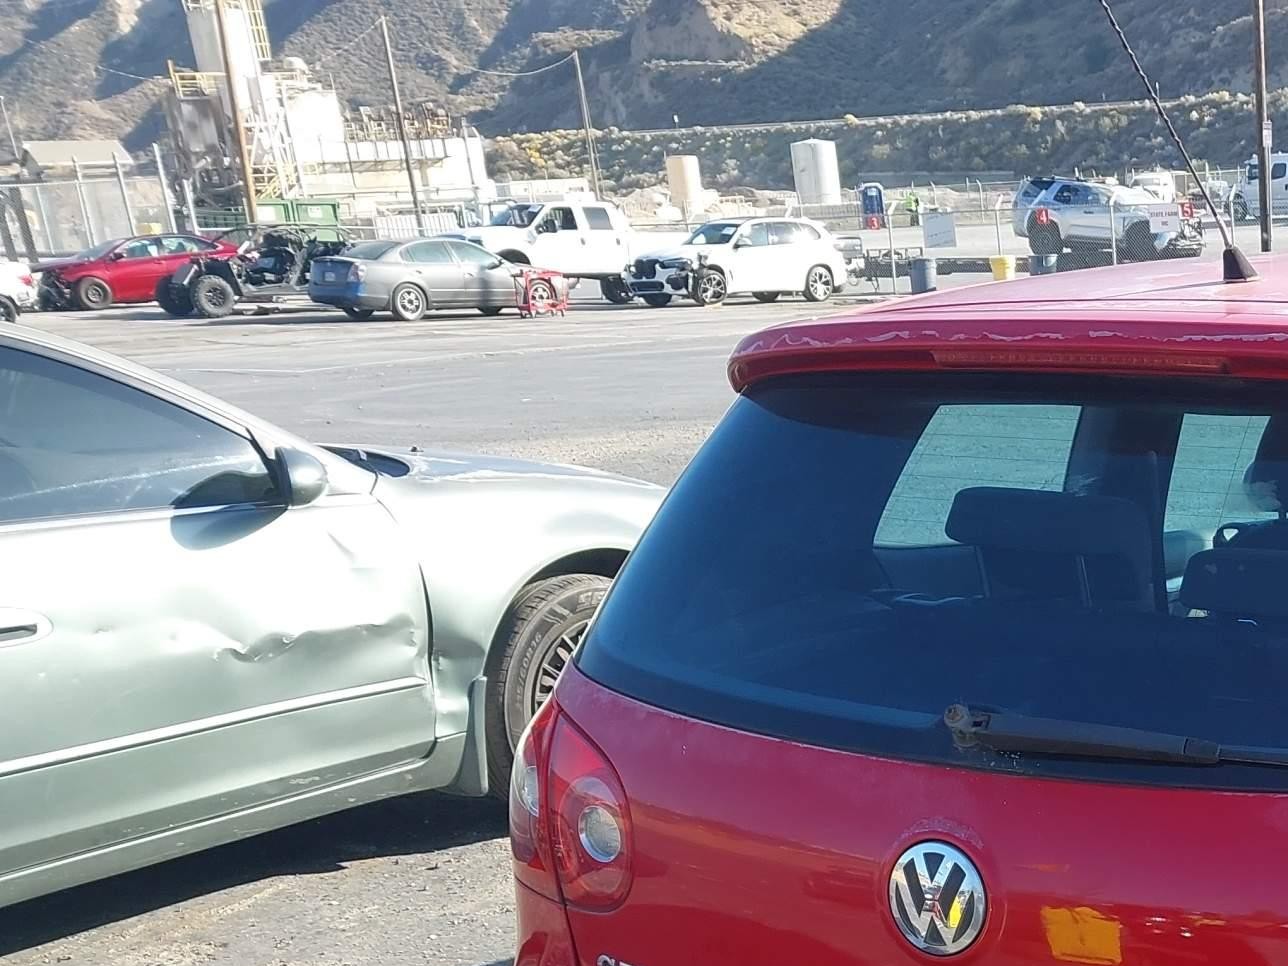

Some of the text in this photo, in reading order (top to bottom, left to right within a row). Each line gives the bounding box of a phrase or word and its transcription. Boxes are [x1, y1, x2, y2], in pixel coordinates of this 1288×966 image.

[1039, 209, 1047, 223] 4
[1183, 203, 1191, 218] 5
[889, 840, 987, 955] VW
